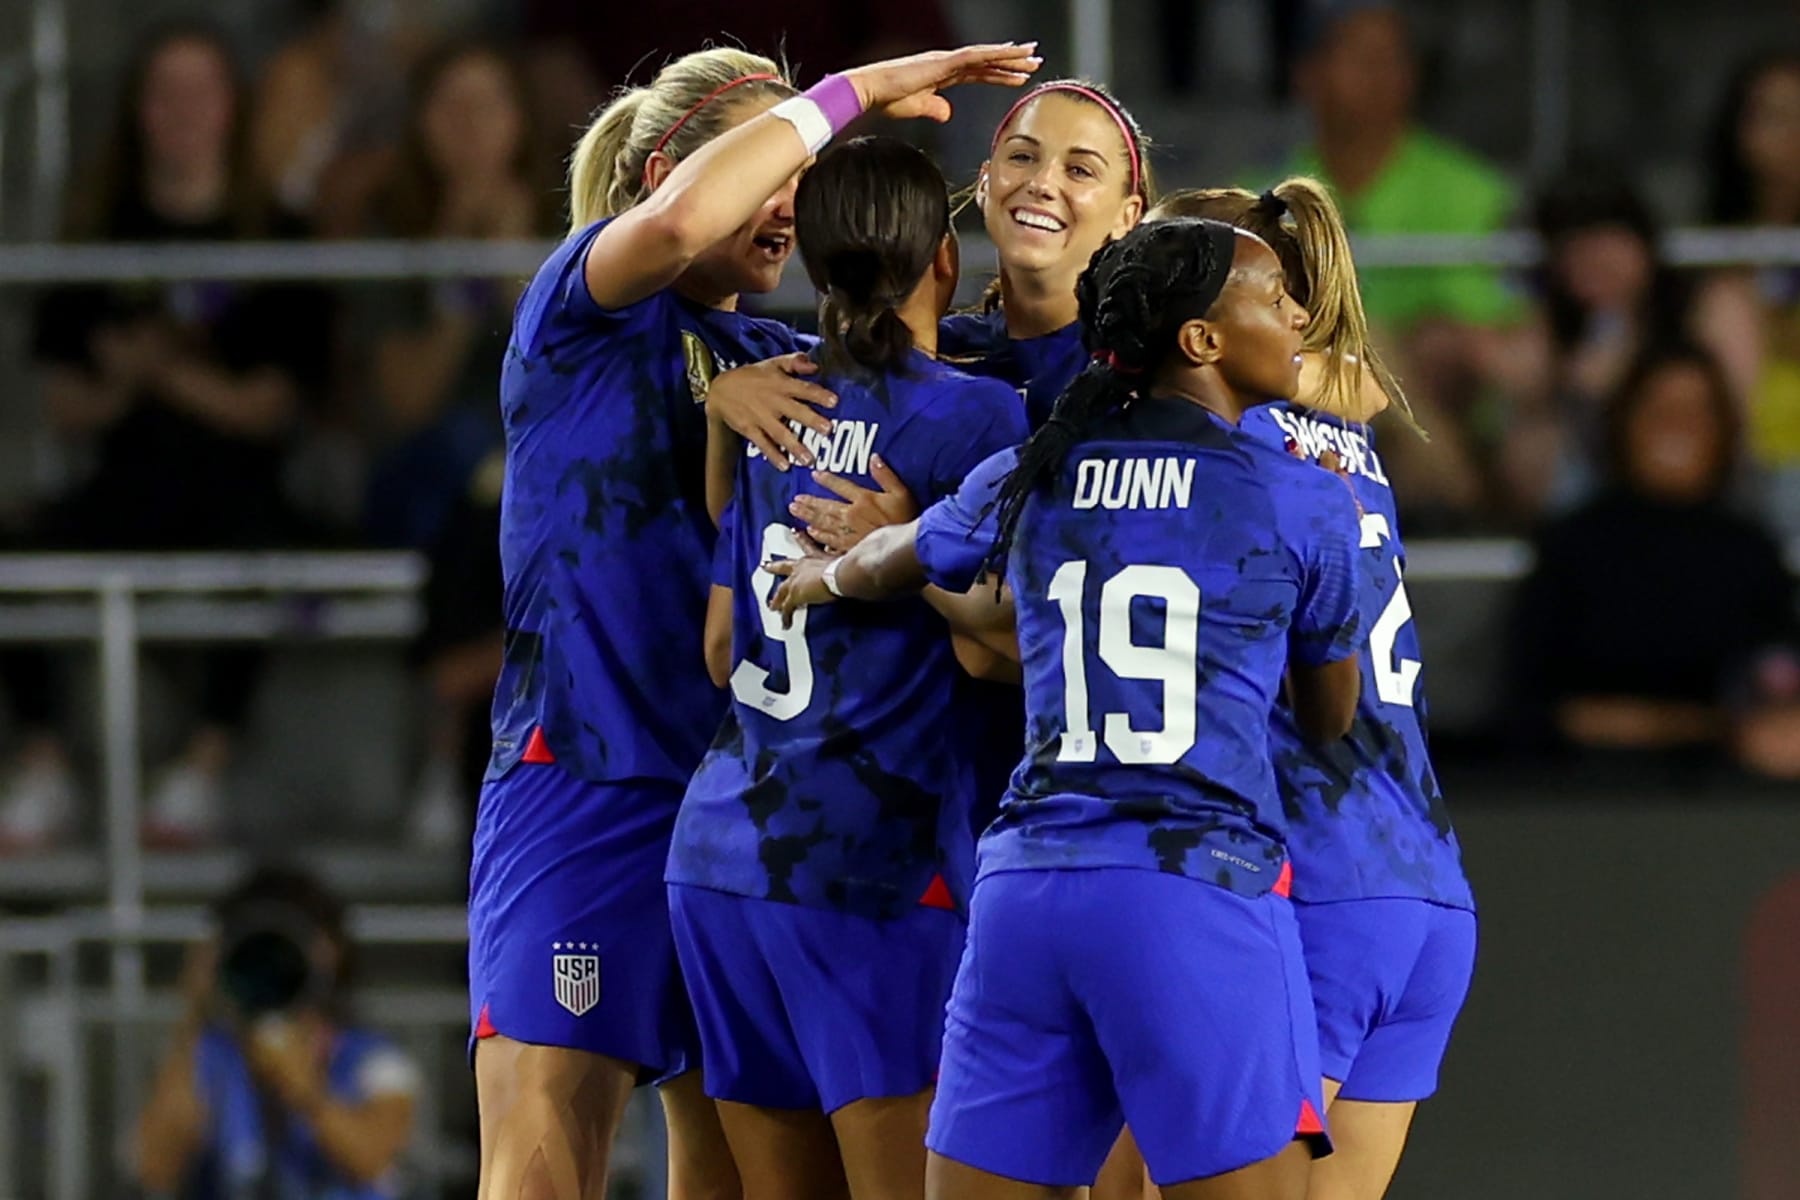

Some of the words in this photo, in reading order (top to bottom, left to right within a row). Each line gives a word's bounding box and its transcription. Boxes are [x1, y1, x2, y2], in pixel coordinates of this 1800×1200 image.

[1072, 458, 1197, 510] DUNN
[730, 522, 814, 721] 9
[1047, 559, 1200, 765] 19
[1360, 513, 1423, 708] 2
[556, 958, 596, 982] USA
